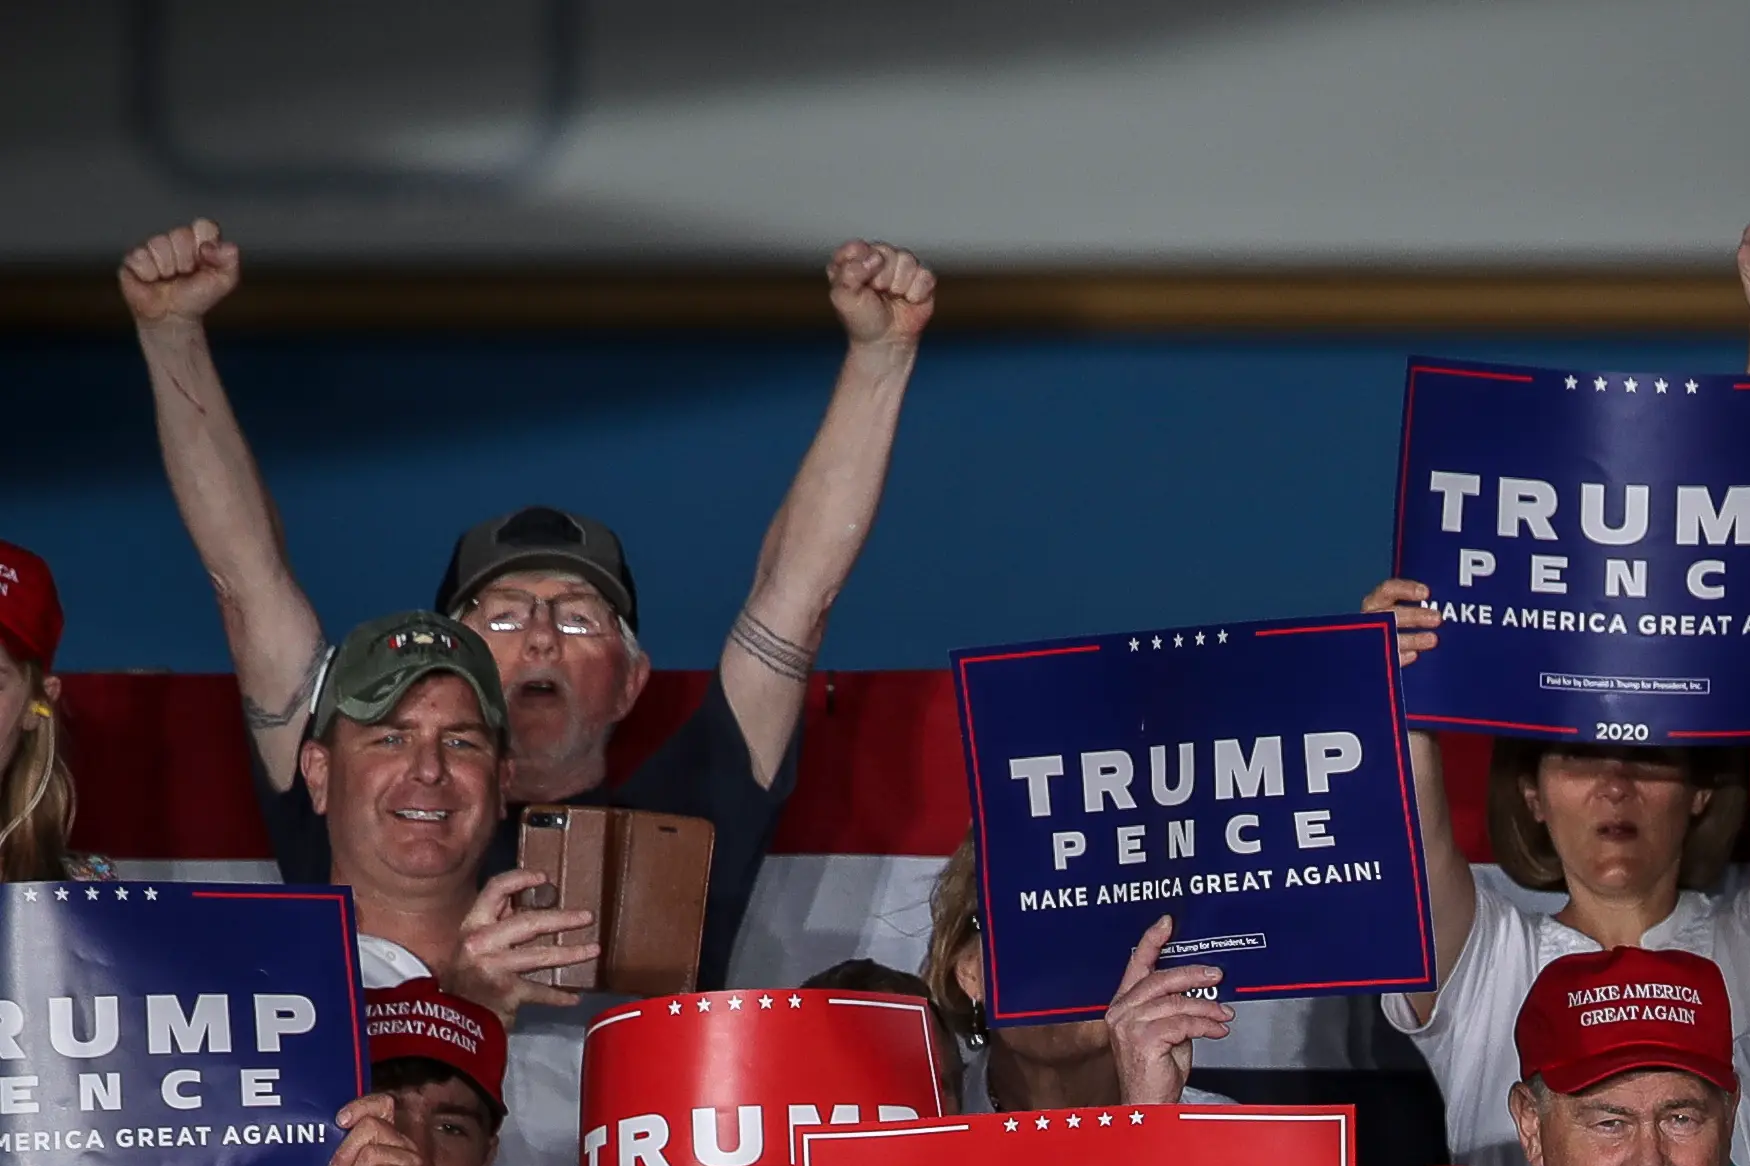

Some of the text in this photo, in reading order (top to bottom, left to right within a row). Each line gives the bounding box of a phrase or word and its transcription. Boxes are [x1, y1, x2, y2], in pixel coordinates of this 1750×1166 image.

[1503, 608, 1627, 634] AMERICA
[1638, 613, 1732, 635] GREAT
[1596, 723, 1649, 740] 2020
[1009, 732, 1362, 817] TRUMP
[1053, 810, 1335, 870] PENCE
[1020, 861, 1382, 911] MAKE AMERICA GREAT AGAIN!
[1568, 983, 1702, 1008] MAKE AMERICA
[412, 1000, 485, 1041] AMERICA
[1581, 1006, 1695, 1026] GREAT AGAIN
[367, 1020, 477, 1054] GREAT AGAIN
[116, 1126, 211, 1147] GREAT
[222, 1124, 326, 1145] AGAIN!
